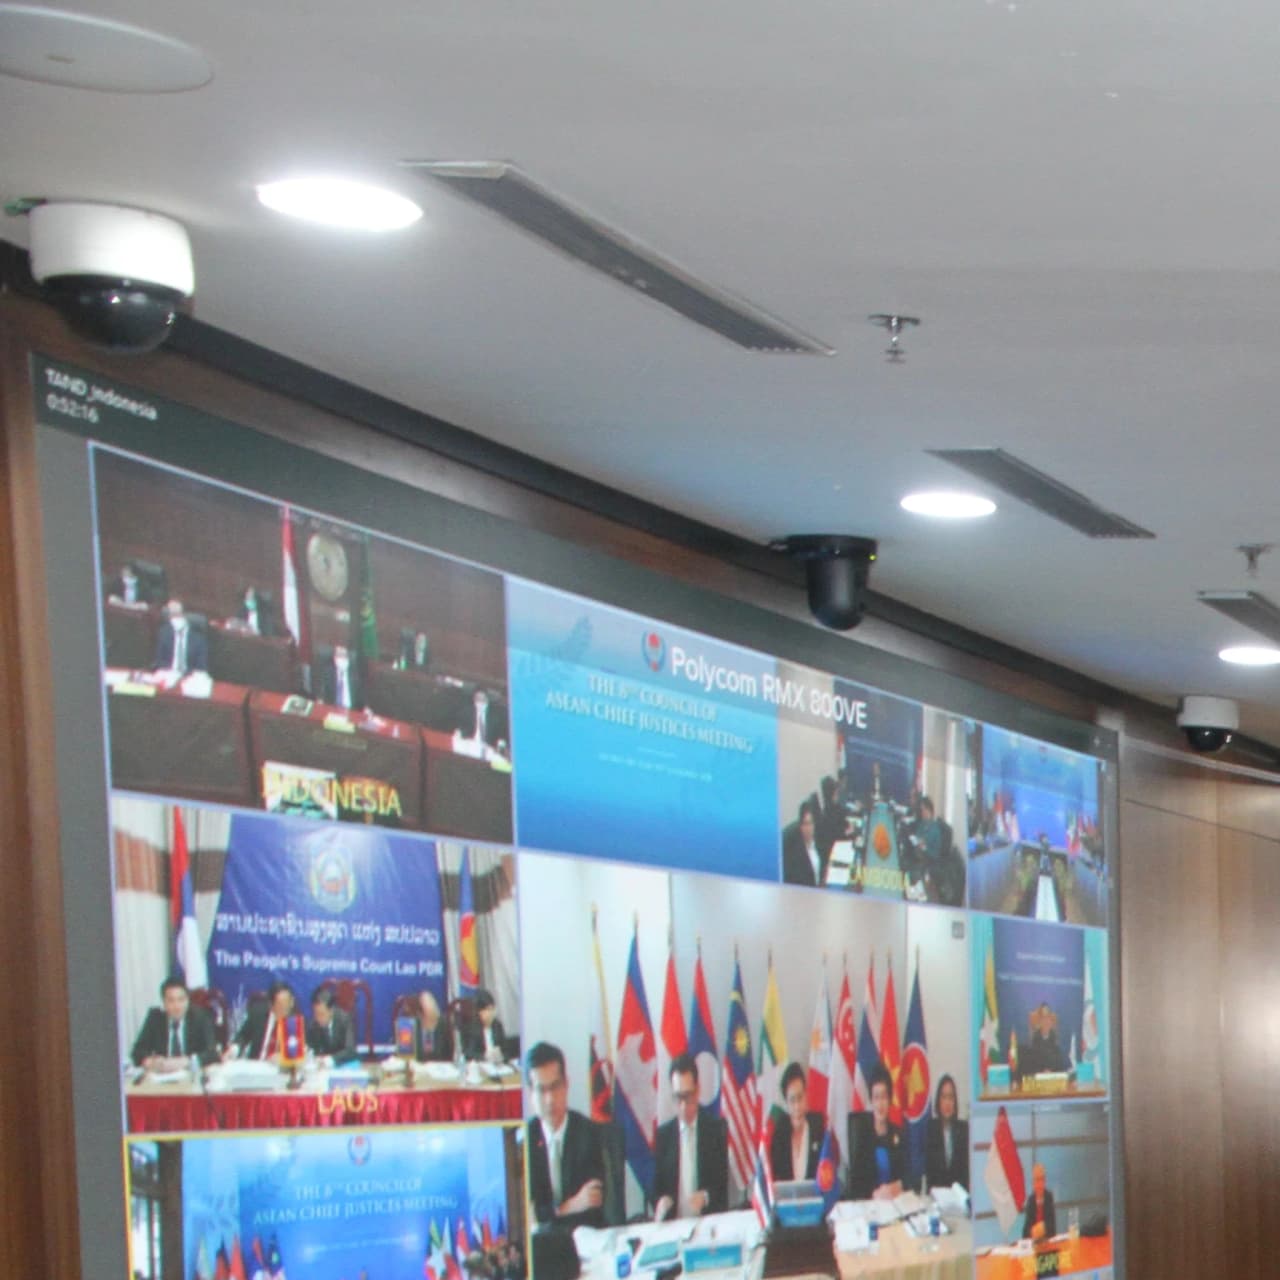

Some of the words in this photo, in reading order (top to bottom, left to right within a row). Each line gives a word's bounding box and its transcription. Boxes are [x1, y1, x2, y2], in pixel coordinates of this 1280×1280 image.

[671, 646, 758, 699] Polycom
[763, 673, 806, 712] RMX
[809, 689, 869, 729] 800VE
[545, 690, 591, 714] ASEAN
[594, 701, 636, 728] CHIEF
[261, 766, 403, 818] INDONESIA
[214, 949, 241, 969] The
[360, 957, 393, 975] Court
[394, 960, 416, 975] Lao
[317, 1084, 379, 1114] LAOS
